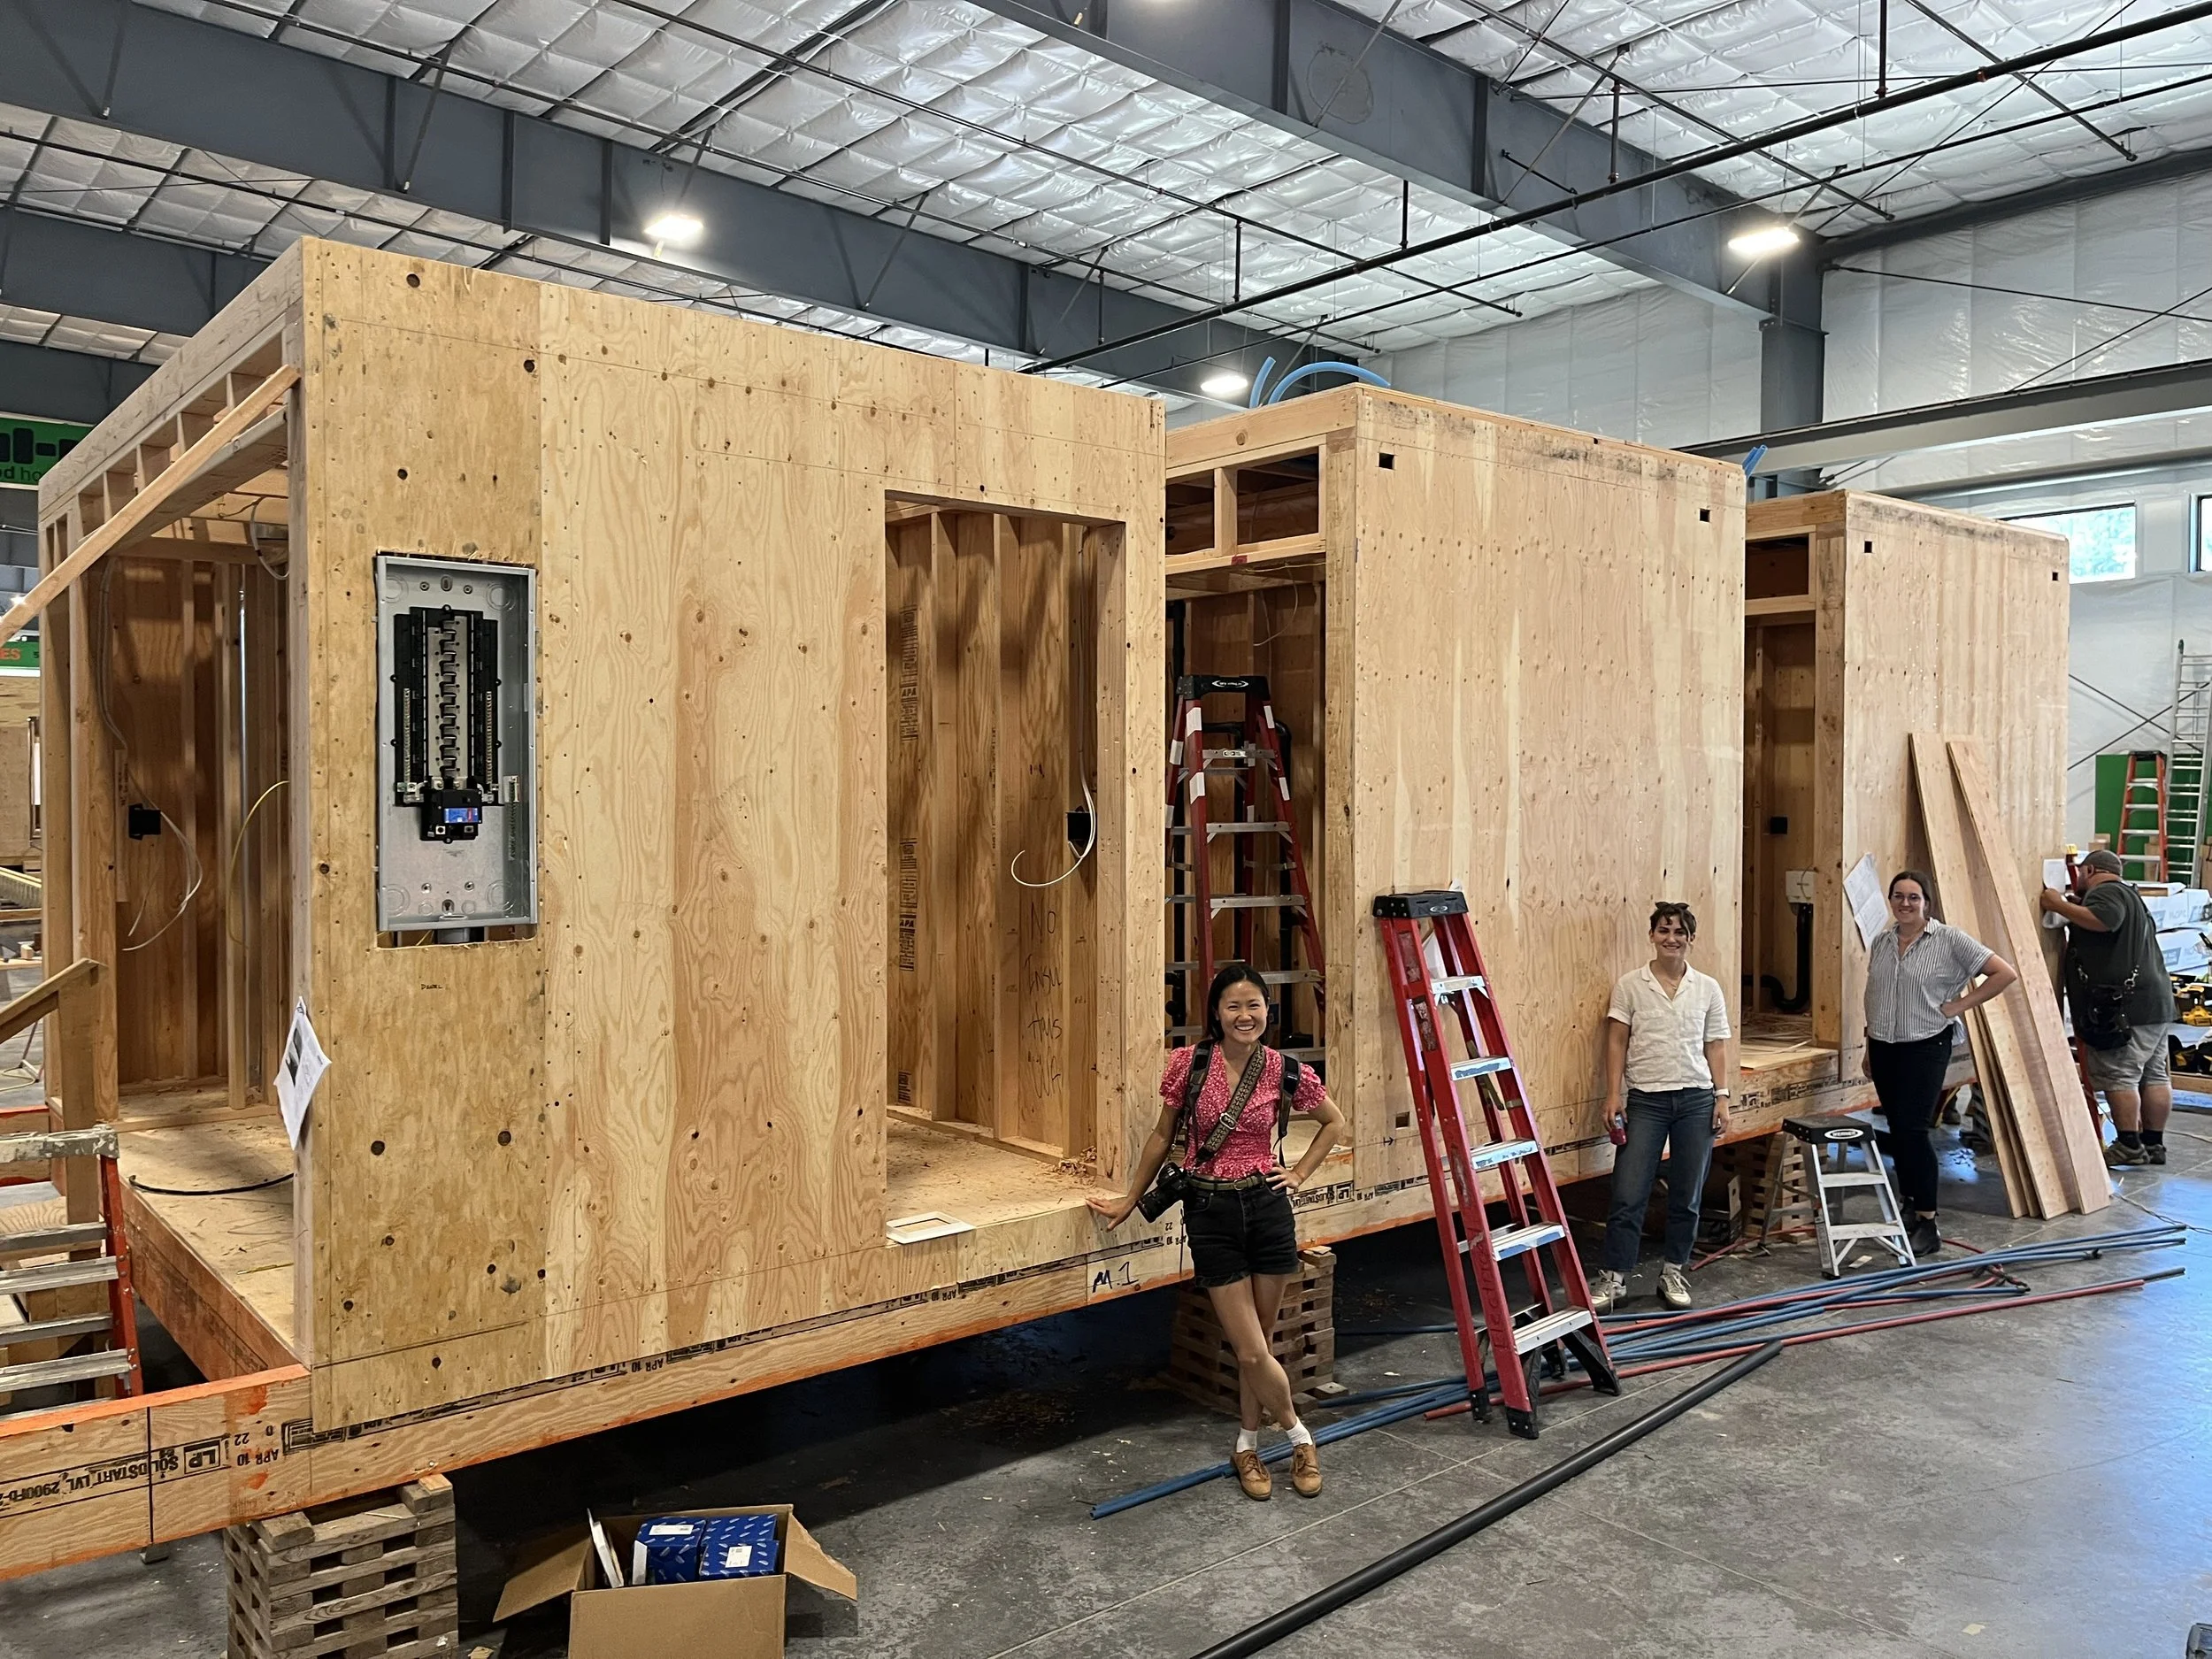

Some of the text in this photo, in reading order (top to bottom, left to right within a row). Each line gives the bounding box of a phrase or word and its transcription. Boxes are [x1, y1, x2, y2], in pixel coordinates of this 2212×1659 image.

[902, 687, 917, 698] APA
[899, 918, 915, 928] APA
[1164, 1221, 1173, 1232] 22
[941, 1288, 957, 1302] APR
[632, 1362, 642, 1373] 10
[646, 1358, 664, 1372] APR
[234, 1432, 250, 1447] 22
[188, 1448, 216, 1469] LP
[237, 1448, 279, 1467] APR 10
[96, 1455, 179, 1486] SOLDSTART
[66, 1475, 93, 1492] LVL
